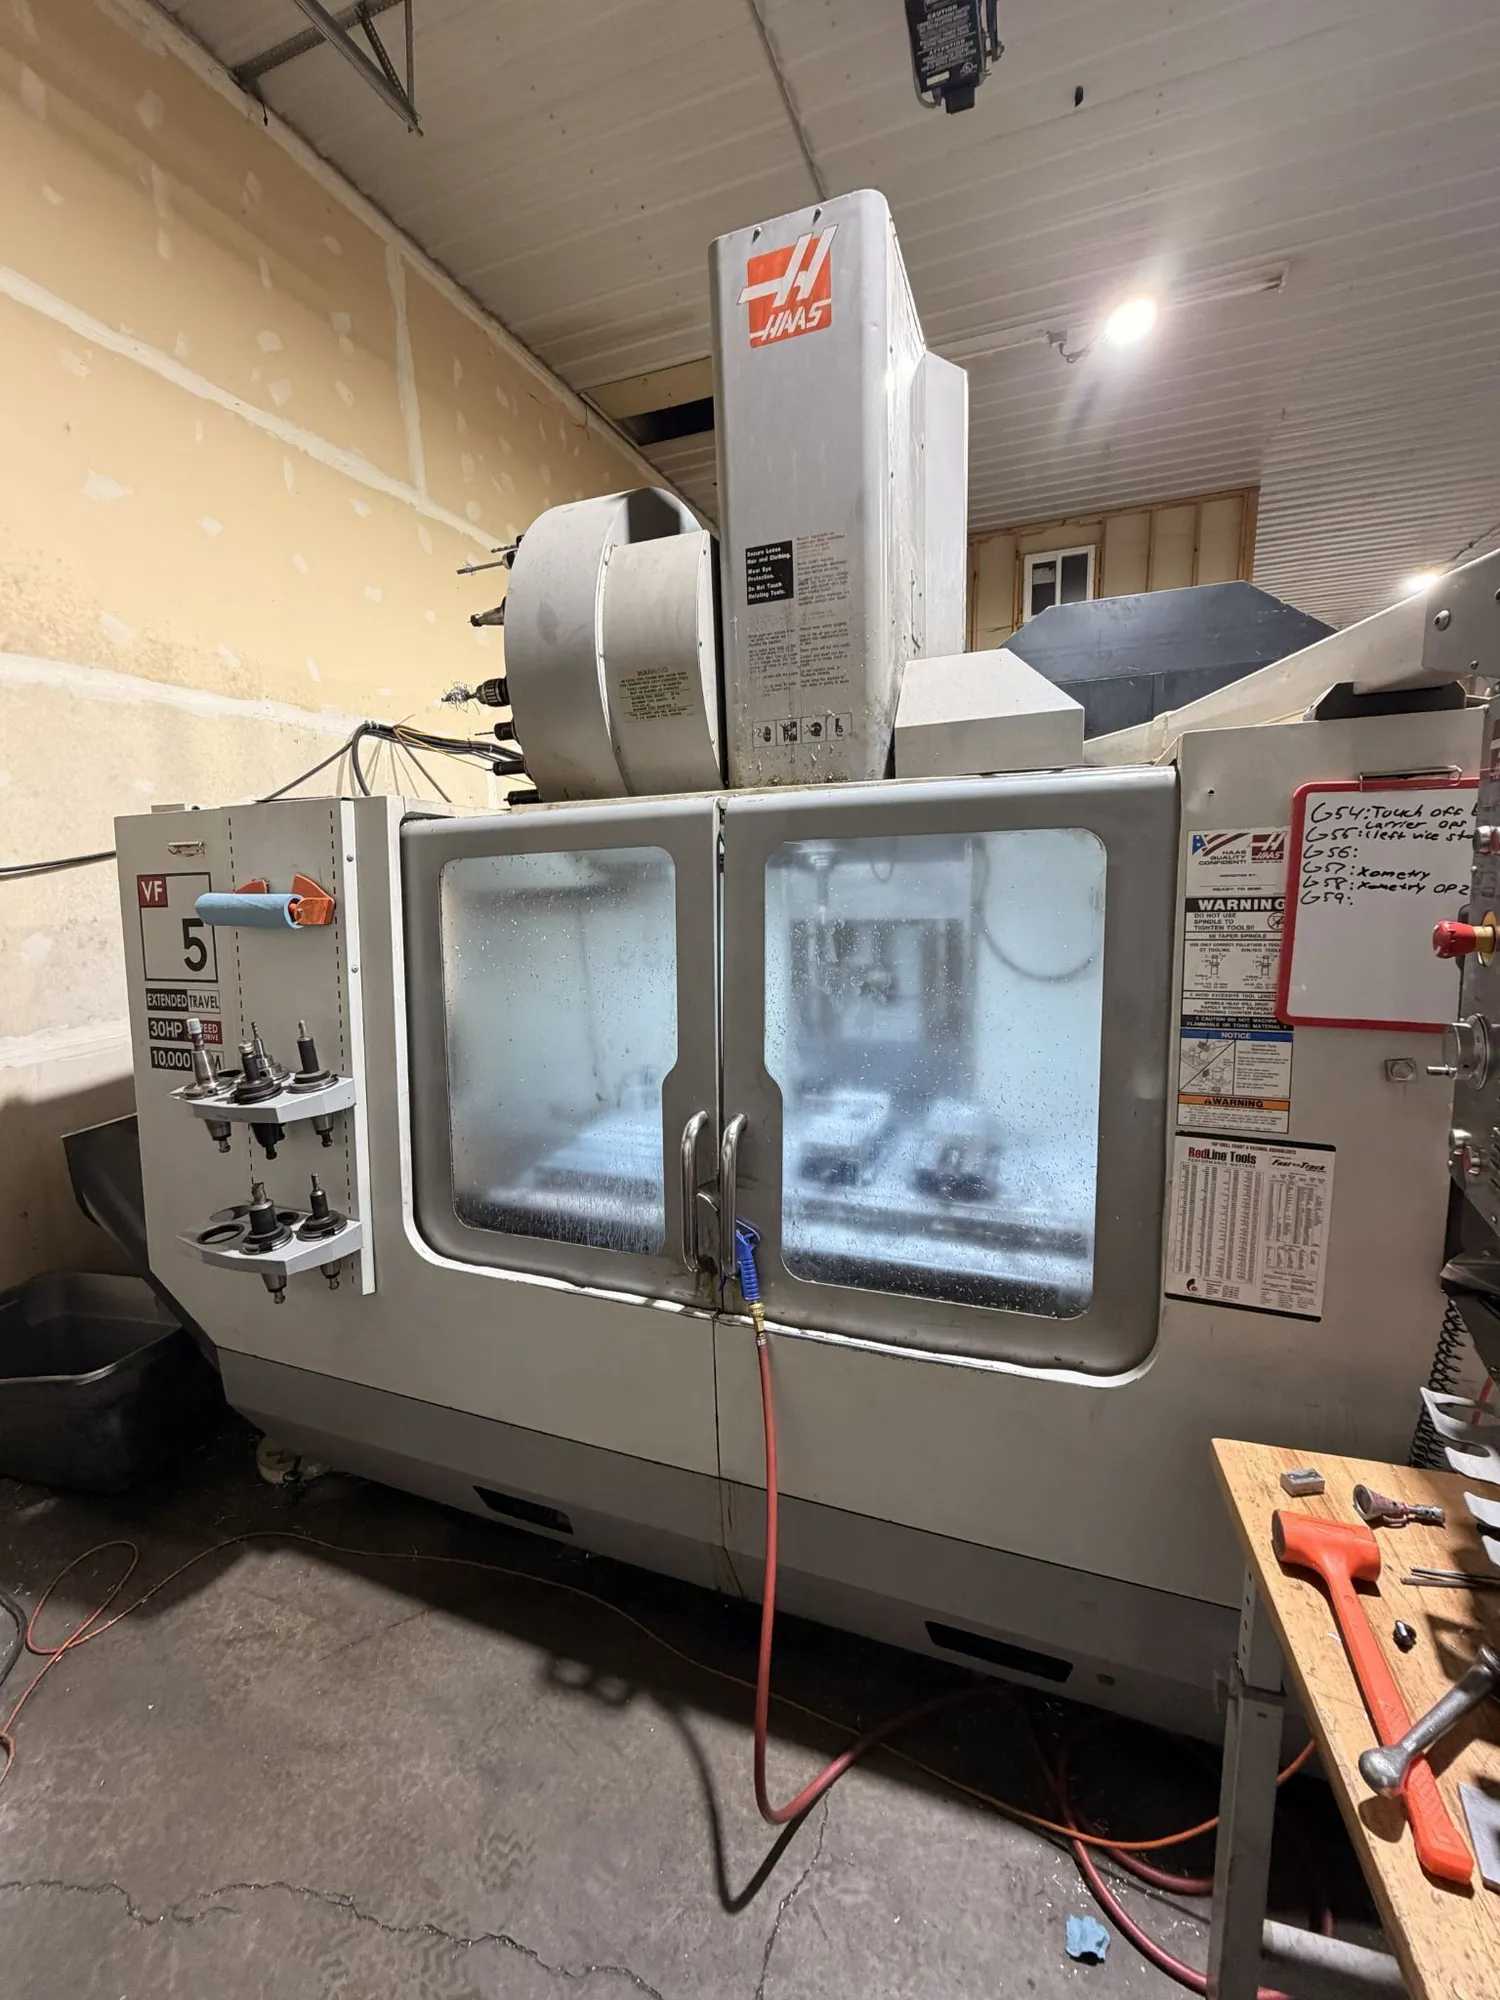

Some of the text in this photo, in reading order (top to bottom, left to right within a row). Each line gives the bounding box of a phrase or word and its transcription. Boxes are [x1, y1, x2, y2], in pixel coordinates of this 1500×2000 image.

[750, 298, 832, 341] HAAS
[1372, 804, 1424, 819] Touch
[1430, 806, 1464, 818] off
[141, 880, 164, 902] VF
[1198, 899, 1284, 911] WARNING
[182, 918, 208, 972] 5
[147, 993, 187, 1007] EXTENDED
[189, 994, 220, 1009] TRAVEL
[150, 1021, 183, 1038] 30HP
[1221, 1031, 1251, 1039] NOTICE
[152, 1050, 191, 1068] 10,000
[1215, 1098, 1264, 1108] WARNING
[1188, 1146, 1257, 1165] RedLine Tools
